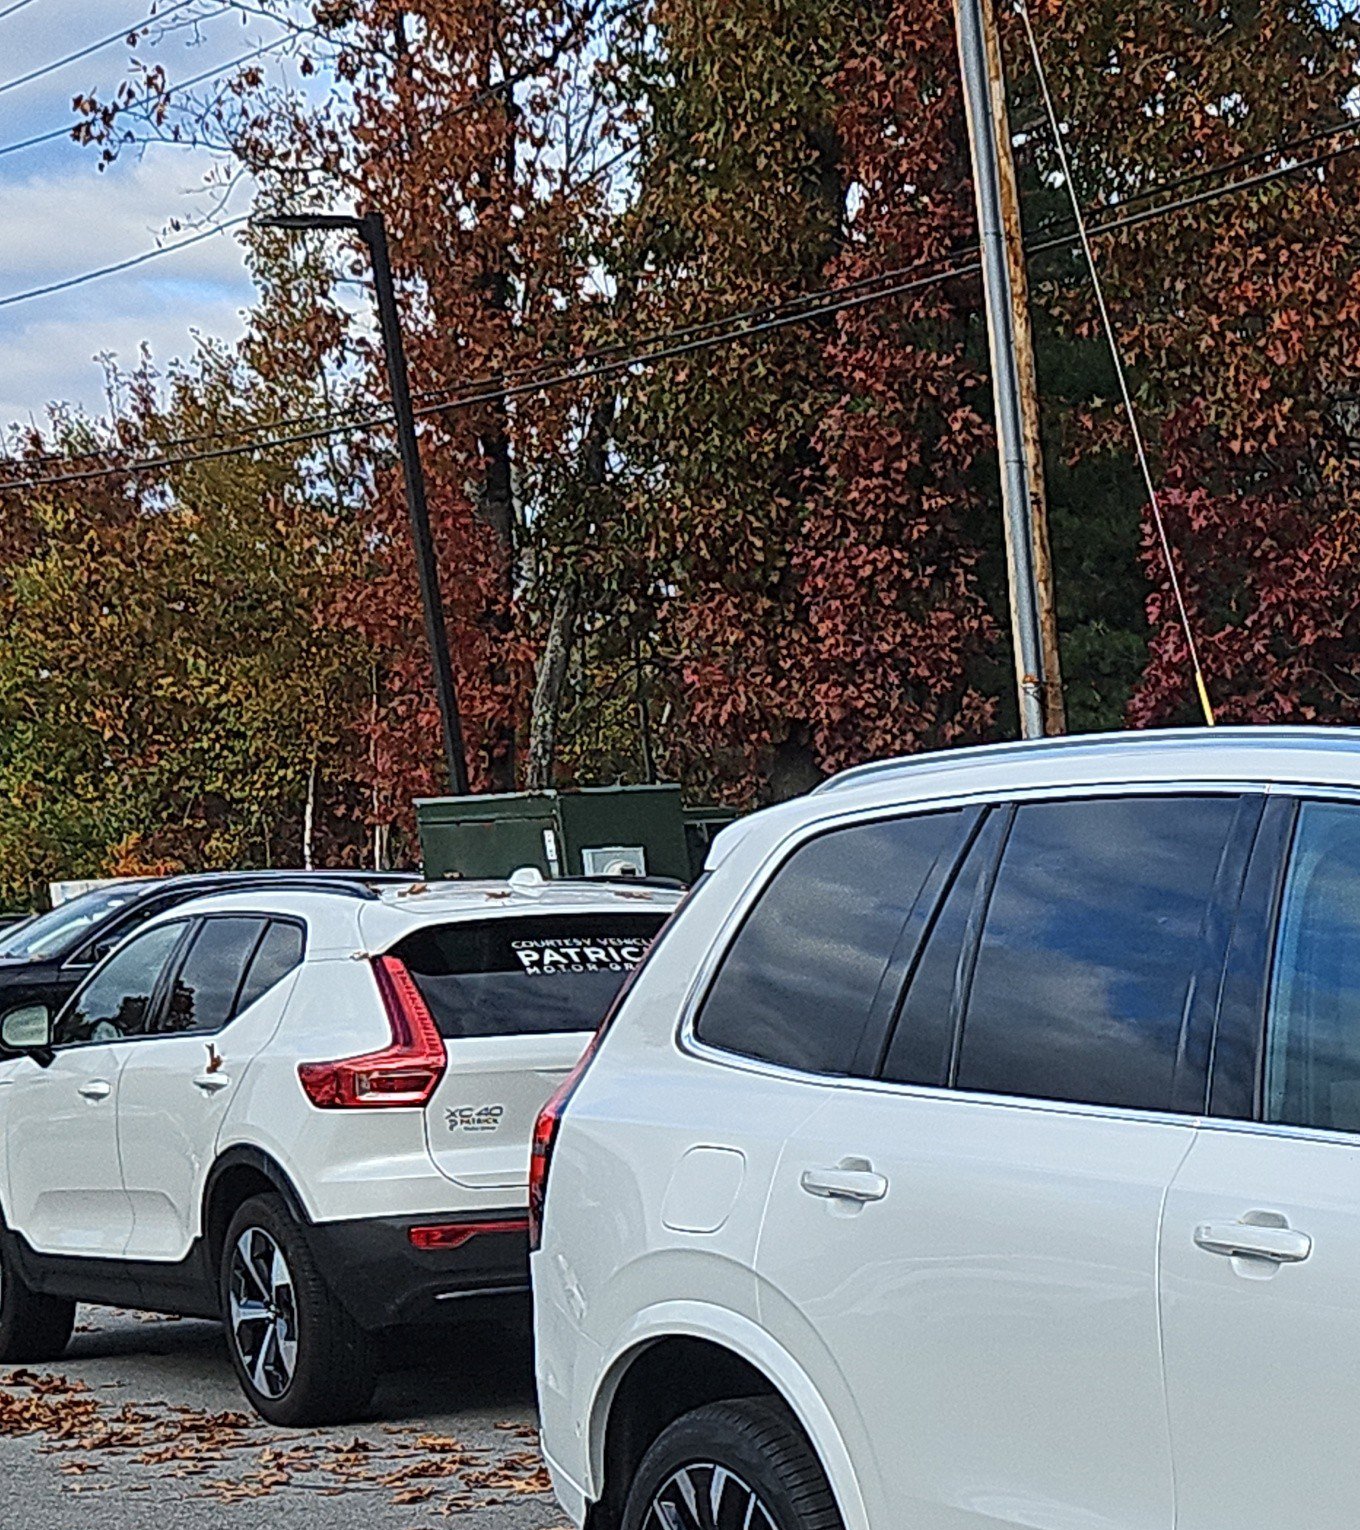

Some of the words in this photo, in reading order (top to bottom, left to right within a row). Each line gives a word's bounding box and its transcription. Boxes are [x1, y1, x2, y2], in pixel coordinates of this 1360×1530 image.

[511, 937, 591, 949] COURTESY
[596, 937, 653, 947] VEHICL
[516, 946, 648, 967] PATRIC
[525, 963, 599, 975] MOTOR
